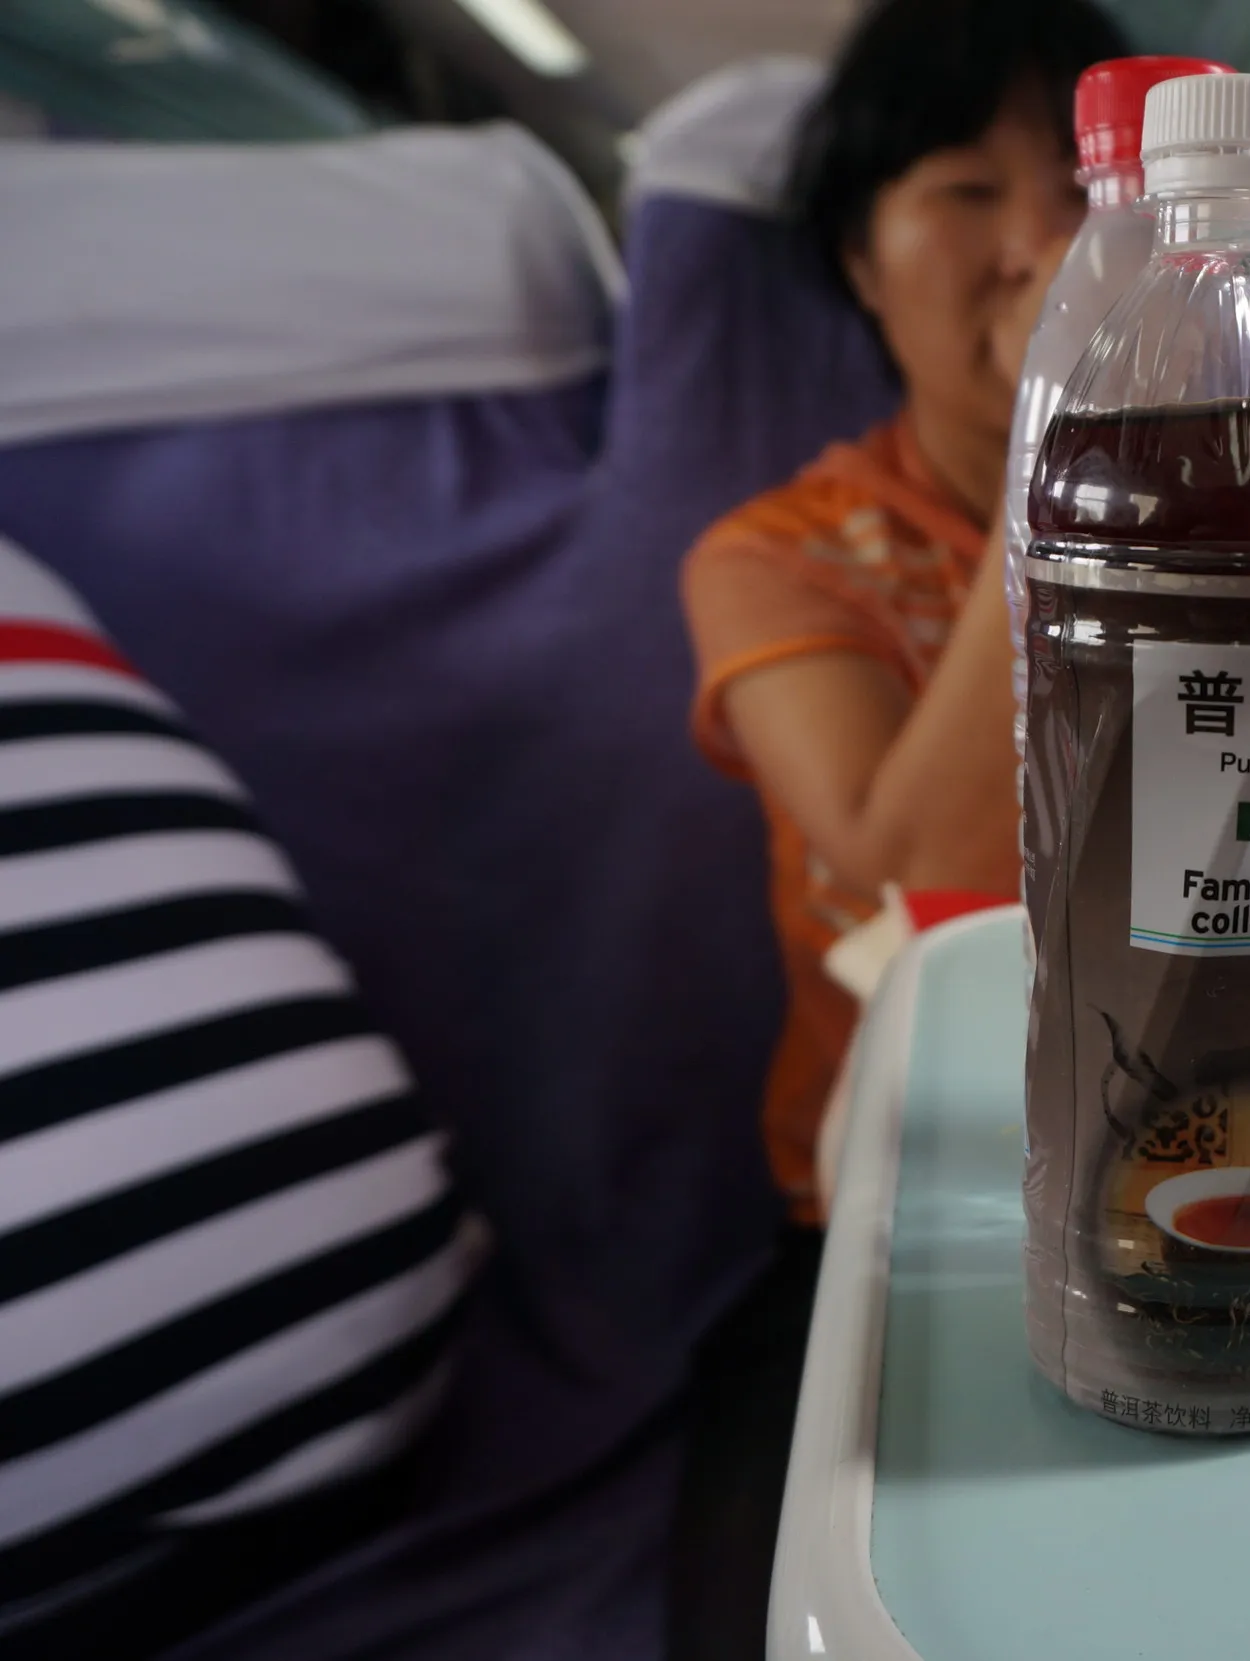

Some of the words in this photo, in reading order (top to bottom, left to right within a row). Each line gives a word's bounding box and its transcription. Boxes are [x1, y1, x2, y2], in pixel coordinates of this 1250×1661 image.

[1100, 1387, 1212, 1430] 普洱茶饮料
